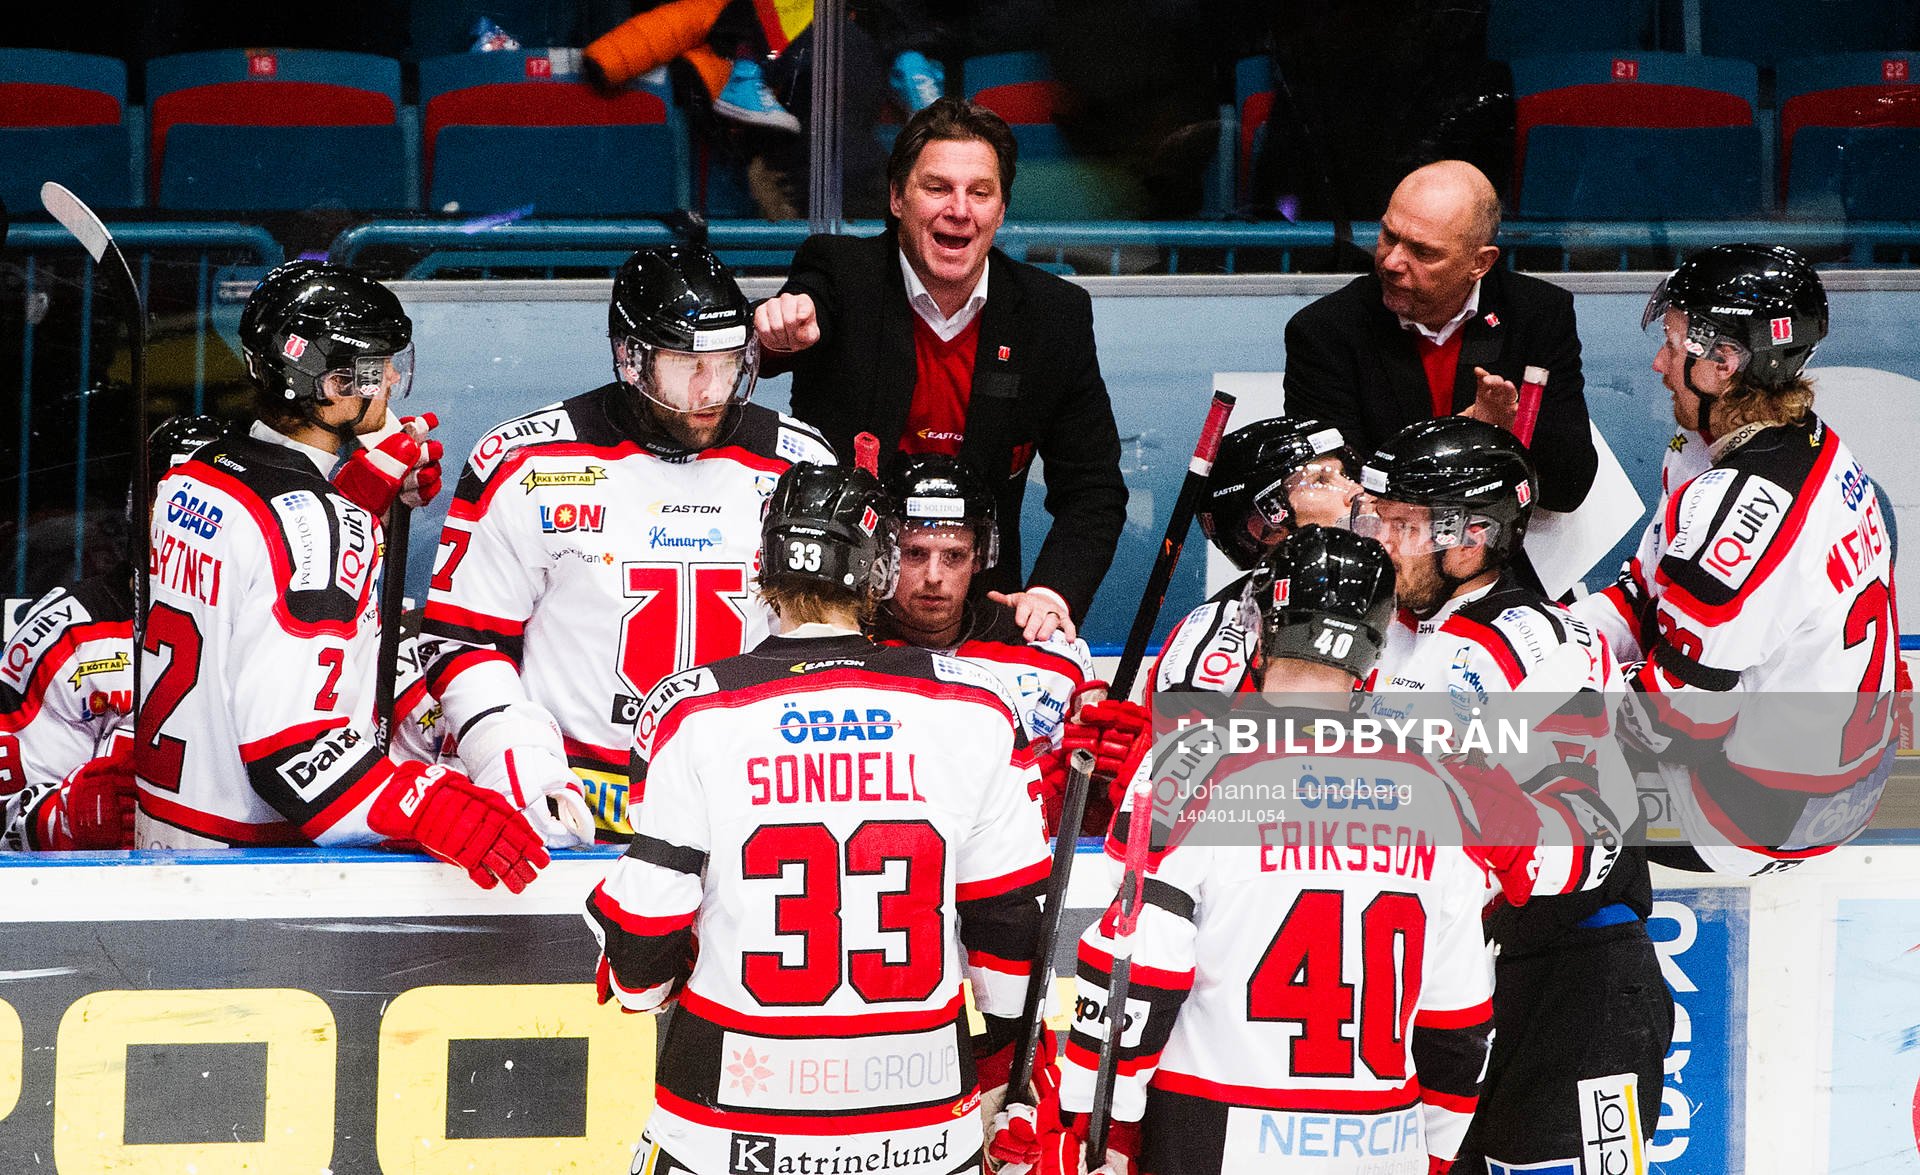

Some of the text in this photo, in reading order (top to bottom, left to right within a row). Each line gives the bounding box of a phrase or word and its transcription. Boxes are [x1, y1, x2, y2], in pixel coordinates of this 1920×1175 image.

[530, 59, 549, 74] 17
[1615, 61, 1635, 77] 21
[1885, 61, 1905, 77] 22
[698, 309, 737, 320] EASTON
[1711, 306, 1753, 316] EASTON
[330, 333, 371, 349] EASTON
[473, 418, 561, 471] IQuity
[217, 456, 248, 473] EASTON
[1212, 483, 1245, 498] EASTON
[1465, 480, 1503, 497] EASTON
[540, 504, 606, 534] LON
[661, 504, 722, 514] EASTON
[339, 499, 369, 590] IQuity
[649, 526, 714, 551] Kinnarps
[1706, 486, 1780, 577] IQuity
[788, 541, 822, 572] 33
[2, 604, 72, 682] IQuity
[1314, 628, 1354, 659] 40
[314, 647, 345, 712] 2
[804, 659, 865, 671] EASTON
[136, 600, 204, 794] 2
[1391, 676, 1426, 691] EASTON
[636, 672, 702, 750] IQuity
[779, 702, 895, 744] ÖBAB
[747, 751, 928, 805] SONDELL
[1257, 820, 1436, 881] ERIKSSON
[742, 820, 946, 1007] 33
[1246, 889, 1427, 1080] 40
[1258, 1110, 1420, 1158] NERCIA
[734, 1130, 950, 1175] Katrinelund
